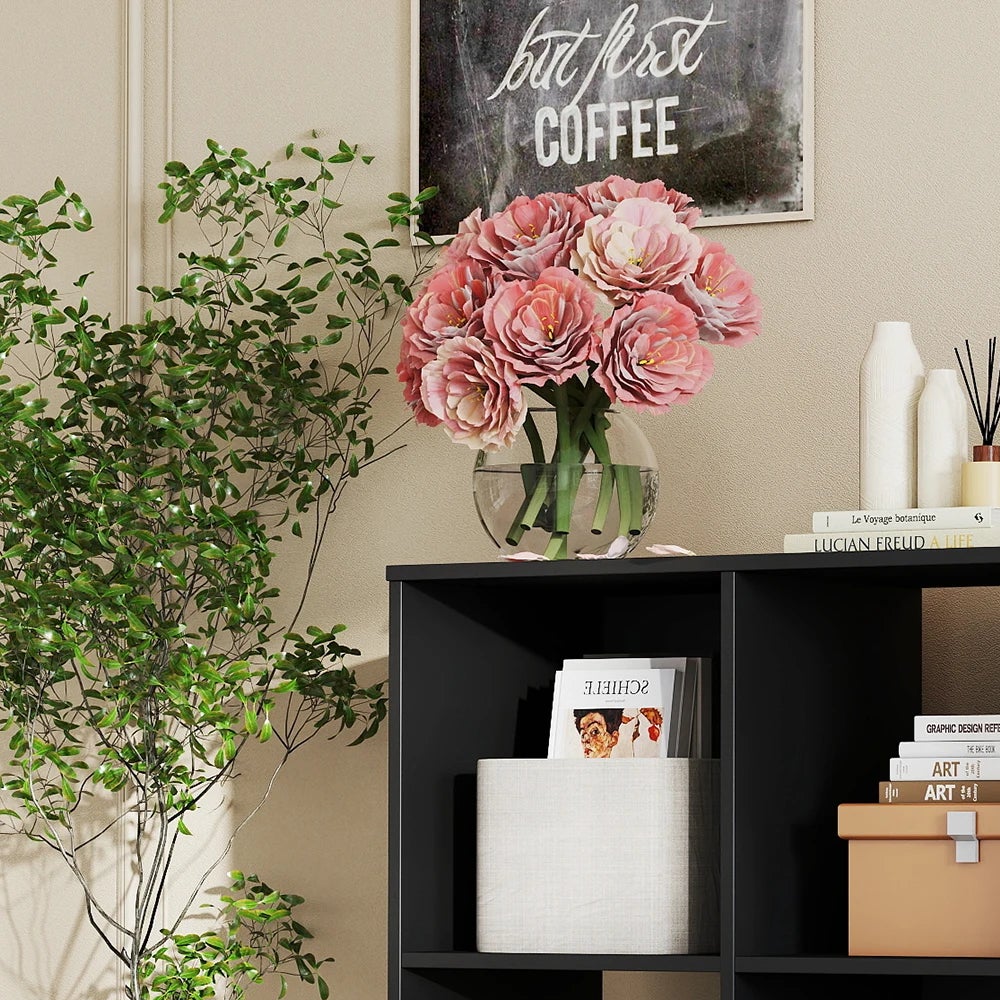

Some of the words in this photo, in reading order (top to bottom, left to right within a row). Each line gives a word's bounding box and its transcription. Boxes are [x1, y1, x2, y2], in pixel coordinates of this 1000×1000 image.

[487, 4, 601, 101] but
[572, 2, 728, 106] first
[534, 95, 680, 168] COFFEE
[851, 514, 862, 525] Le
[863, 513, 893, 526] Voyage
[894, 512, 937, 525] botanique
[814, 536, 871, 553] LUCIAN
[876, 535, 926, 551] FREUD
[929, 535, 940, 549] A
[945, 533, 974, 549] LIFE
[926, 723, 957, 734] GRAPHIC
[958, 723, 983, 733] DESIGN
[932, 761, 961, 777] ART
[924, 784, 956, 801] ART
